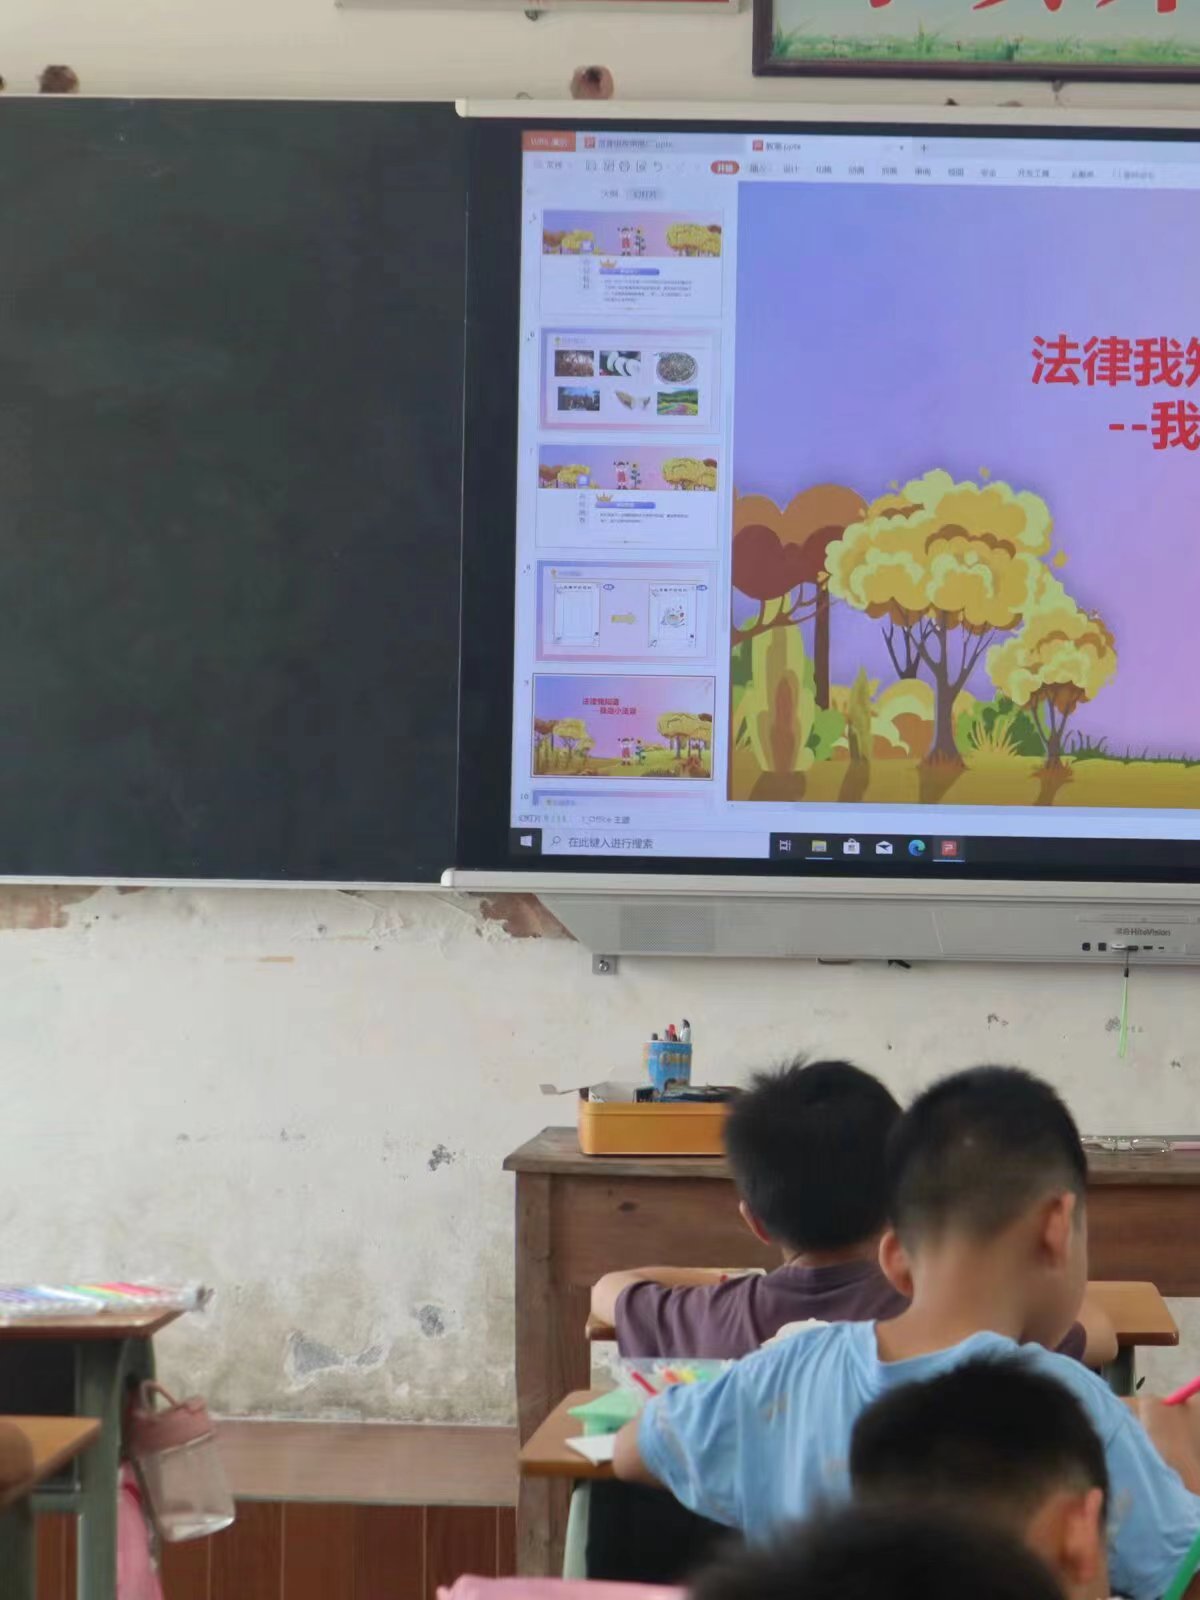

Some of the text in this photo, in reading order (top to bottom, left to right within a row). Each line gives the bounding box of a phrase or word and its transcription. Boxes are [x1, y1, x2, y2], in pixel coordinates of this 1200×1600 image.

[568, 837, 654, 849] 在此键入进行搜索
